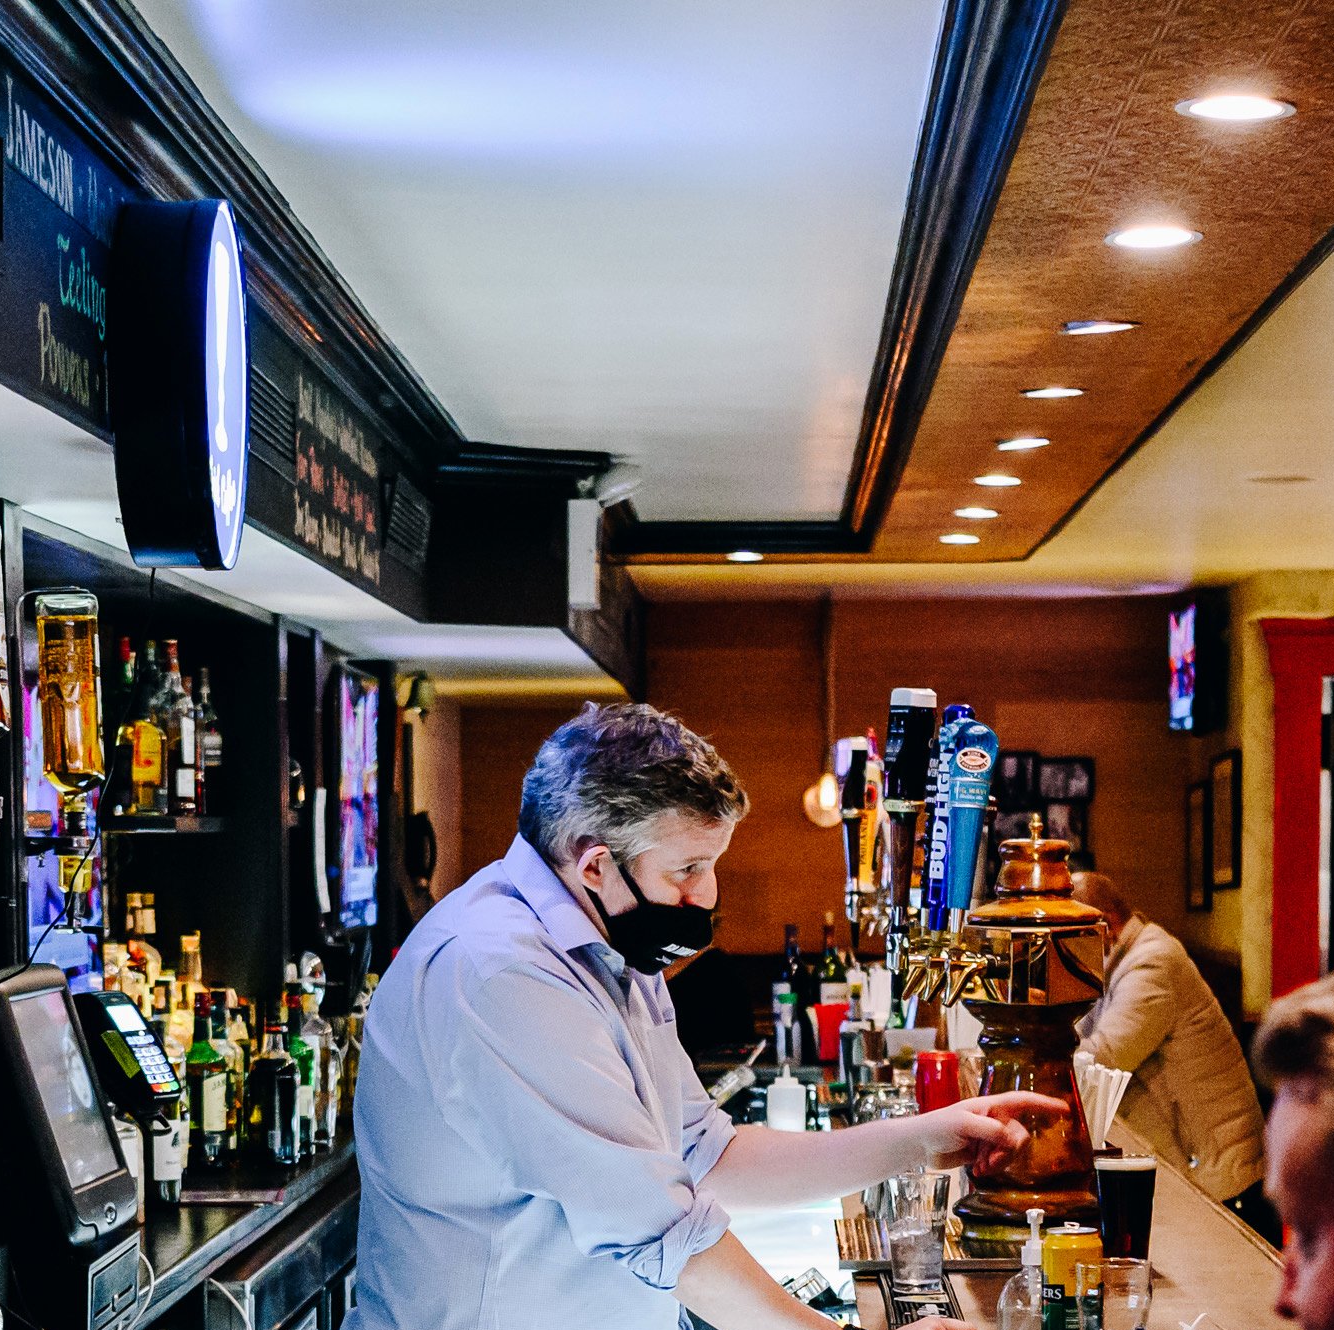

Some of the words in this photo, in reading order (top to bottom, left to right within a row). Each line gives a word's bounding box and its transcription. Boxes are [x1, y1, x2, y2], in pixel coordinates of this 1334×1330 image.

[6, 74, 74, 217] JAMESON
[57, 233, 106, 341] Teeling
[935, 743, 954, 817] LIGH
[929, 820, 948, 880] BUD
